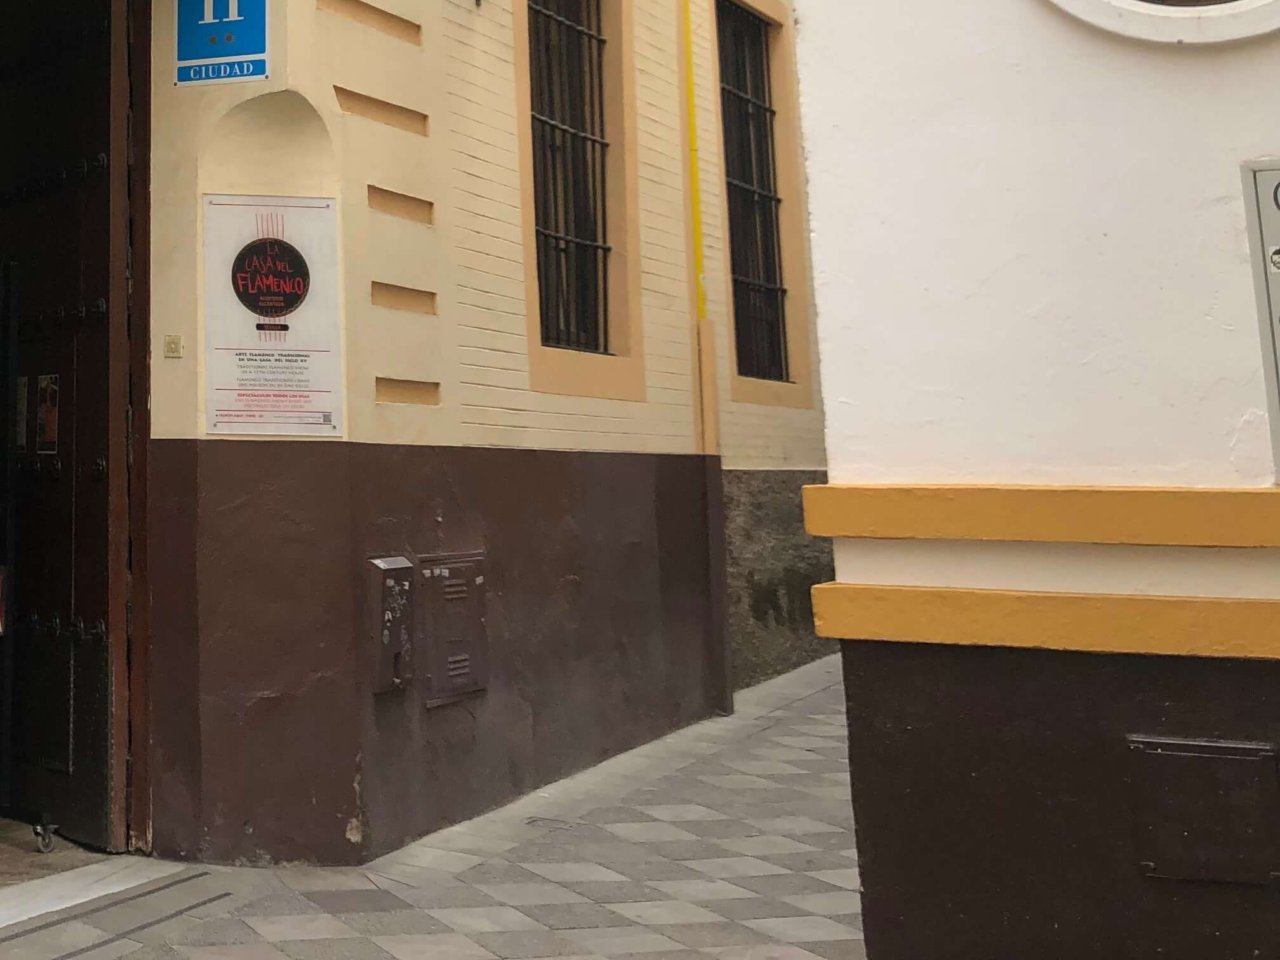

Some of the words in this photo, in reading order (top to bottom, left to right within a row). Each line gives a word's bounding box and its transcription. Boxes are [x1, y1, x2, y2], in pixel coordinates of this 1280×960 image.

[190, 61, 254, 80] CIUDAD
[245, 255, 274, 274] CASA
[275, 260, 294, 274] DEL
[236, 272, 305, 295] FLAMENCO
